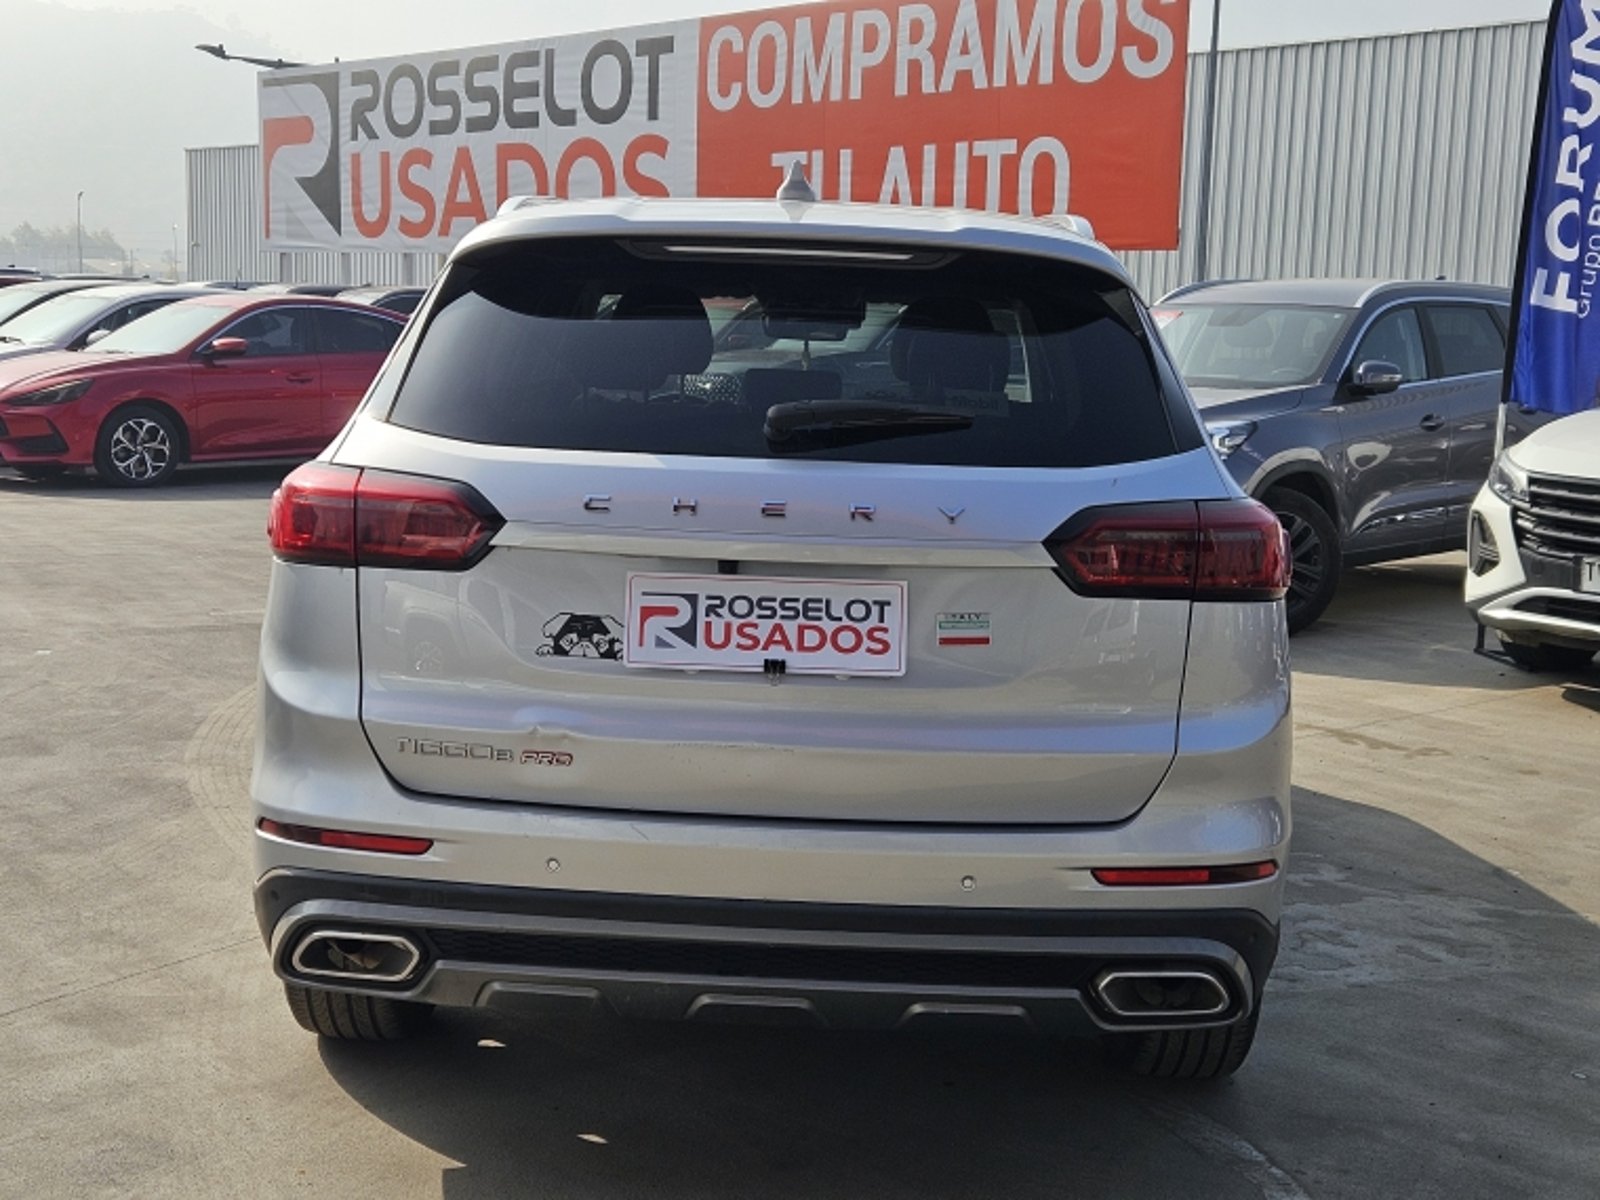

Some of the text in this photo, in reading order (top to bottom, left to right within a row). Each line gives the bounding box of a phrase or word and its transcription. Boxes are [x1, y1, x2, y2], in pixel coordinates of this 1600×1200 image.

[705, 0, 1176, 112] COMPRAMOS
[349, 34, 675, 142] ROSSELOT
[349, 132, 671, 240] USADOS
[877, 135, 1071, 218] AUTO
[583, 493, 966, 525] CHERY
[703, 595, 892, 624] ROSSELOT
[703, 621, 892, 656] USADOS
[519, 749, 574, 767] PRO
